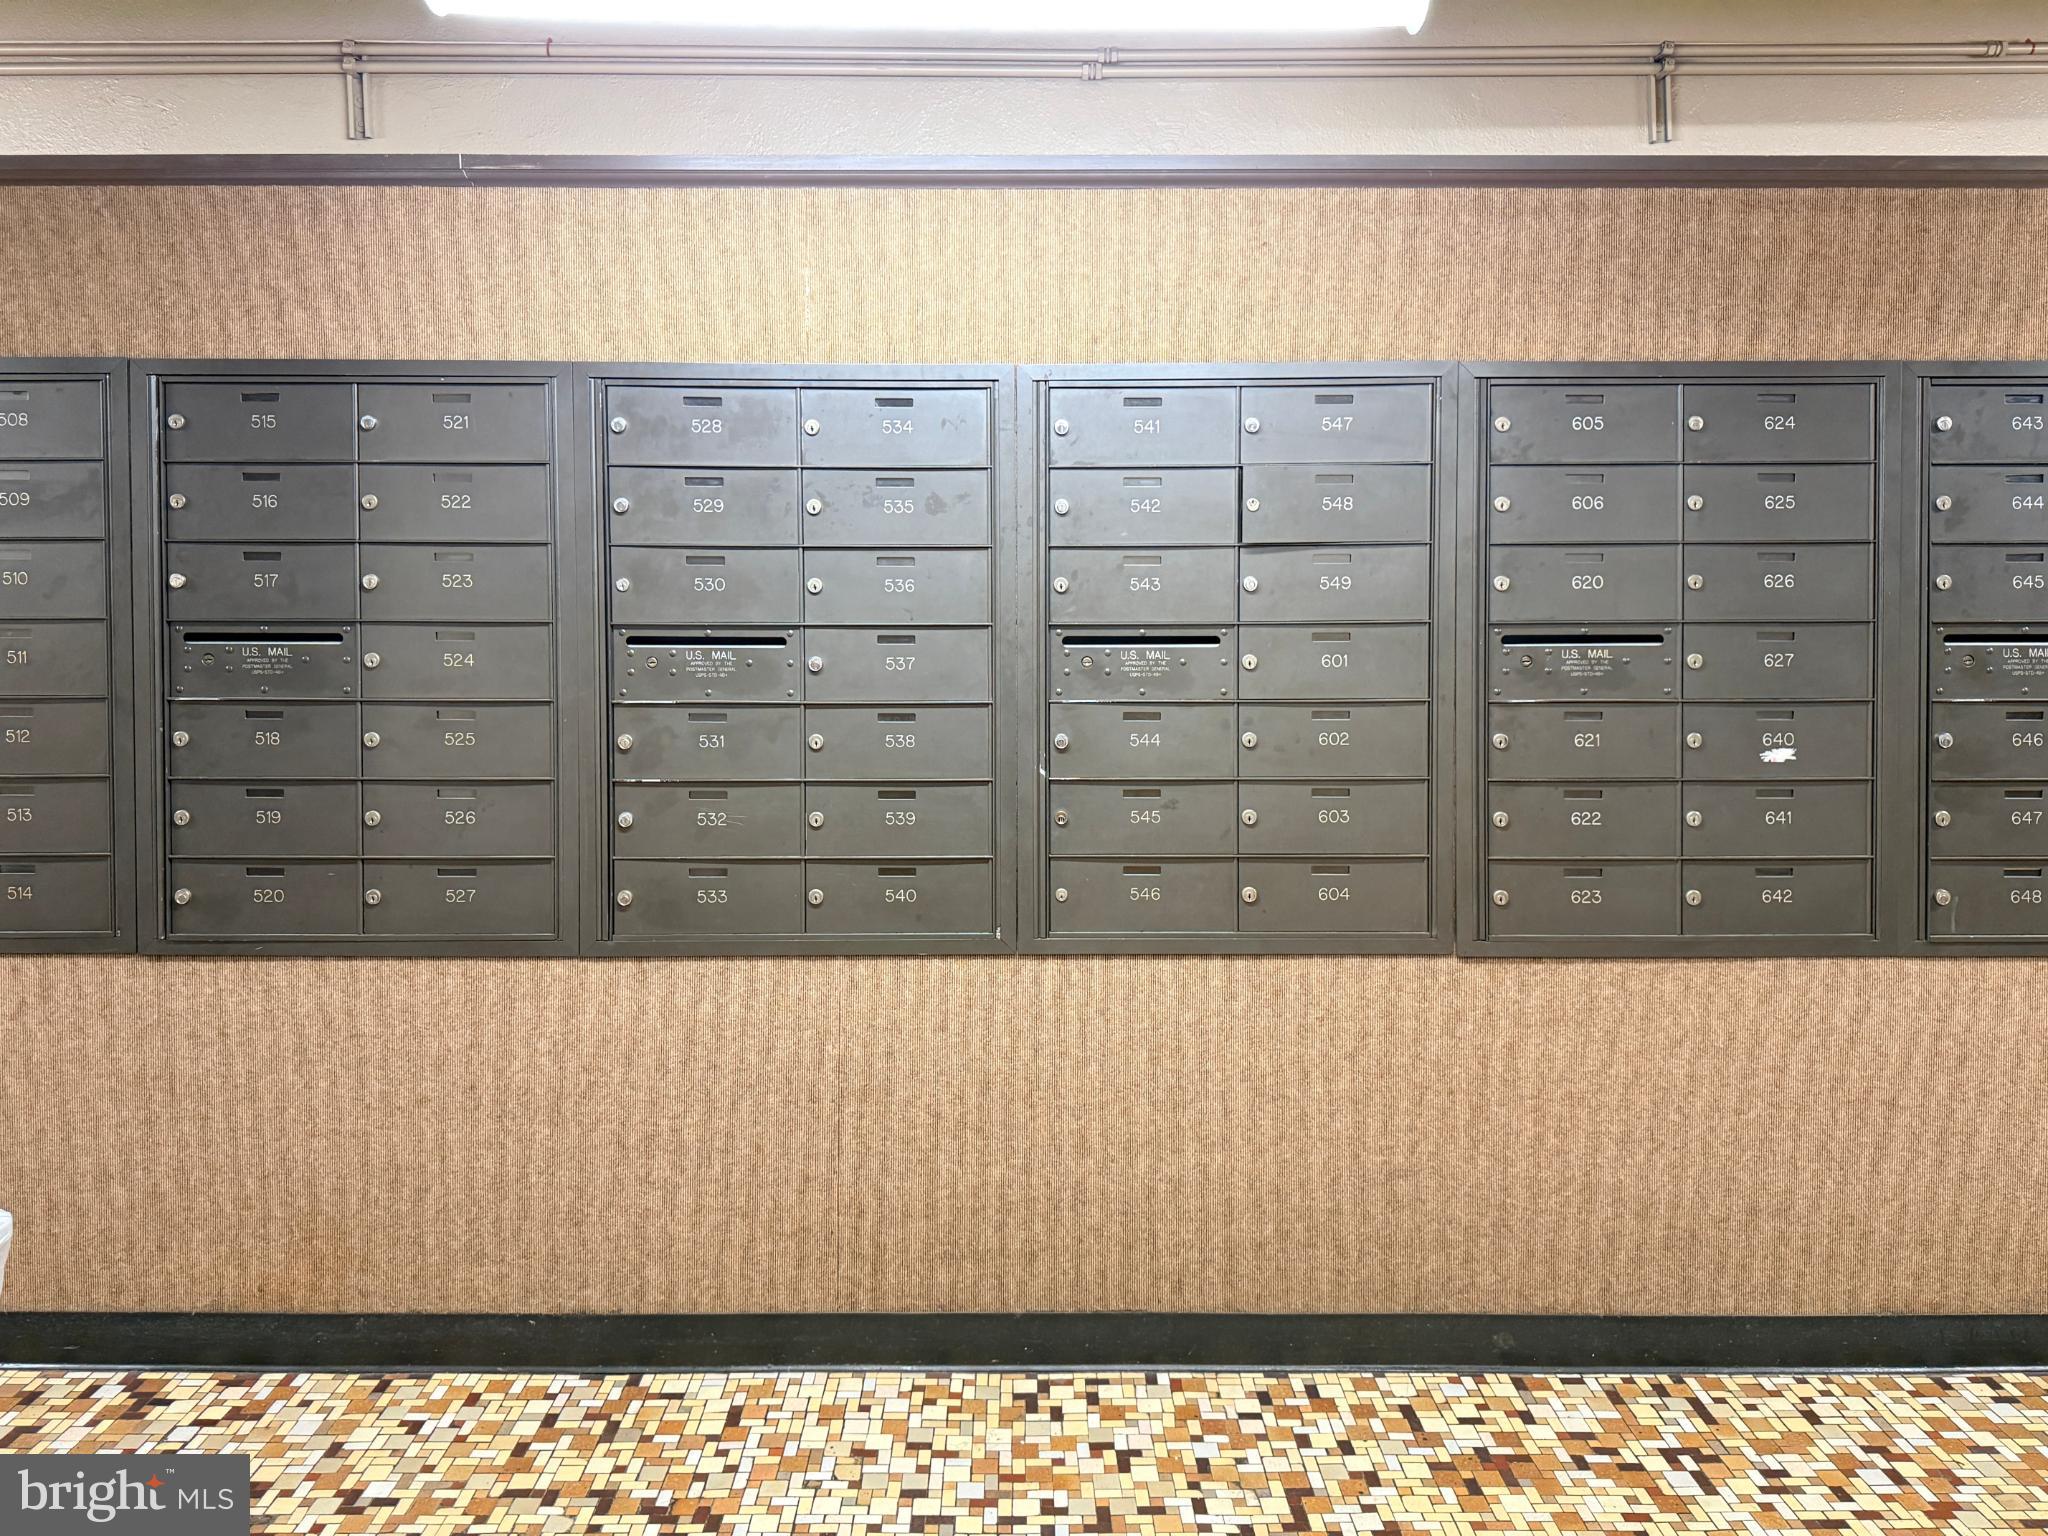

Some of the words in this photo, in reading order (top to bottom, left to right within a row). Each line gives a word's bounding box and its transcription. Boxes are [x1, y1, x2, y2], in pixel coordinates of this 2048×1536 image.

[0, 412, 29, 427] 508
[251, 414, 277, 429] 515
[443, 415, 469, 430] 521
[691, 418, 722, 434] 528
[882, 419, 914, 434] 534
[1133, 419, 1160, 434] 541
[1321, 416, 1354, 432] 547
[1572, 416, 1604, 431] 605
[1764, 415, 1796, 430] 624
[2011, 416, 2044, 431] 643
[0, 492, 30, 506] 509
[252, 494, 278, 508] 516
[441, 494, 472, 509] 522
[693, 498, 724, 513] 529
[883, 499, 914, 514] 535
[1130, 498, 1161, 513] 542
[1321, 496, 1354, 511] 548
[1571, 495, 1604, 510] 606
[1764, 495, 1796, 510] 625
[2012, 495, 2045, 510] 644
[2, 571, 28, 585] 510
[253, 573, 279, 588] 517
[442, 573, 473, 588] 523
[694, 577, 726, 592] 530
[884, 578, 915, 593] 536
[1129, 577, 1161, 592] 543
[1319, 575, 1352, 590] 549
[1571, 575, 1604, 590] 620
[1763, 574, 1795, 588] 626
[2012, 574, 2045, 589] 645
[6, 650, 27, 664] 511
[242, 647, 261, 657] U.S.
[267, 647, 293, 657] MAIL
[685, 650, 705, 660] U.S.
[711, 650, 737, 660] MAIL
[1120, 650, 1139, 660] U.S.
[1146, 650, 1171, 660] MAIL
[1561, 649, 1581, 659] U.S.
[1587, 649, 1613, 659] MAIL
[2002, 648, 2022, 658] U.S.
[443, 653, 475, 667] 524
[885, 656, 916, 671] 537
[1321, 654, 1348, 668] 601
[1764, 653, 1795, 668] 627
[5, 729, 31, 743] 512
[255, 731, 280, 746] 518
[444, 732, 476, 746] 525
[698, 734, 725, 748] 531
[885, 734, 916, 748] 538
[1129, 733, 1161, 747] 544
[1318, 731, 1350, 746] 602
[1574, 733, 1600, 748] 621
[1762, 732, 1795, 747] 640
[2012, 732, 2044, 747] 646
[7, 807, 33, 822] 513
[256, 810, 281, 824] 519
[444, 810, 476, 825] 526
[697, 812, 726, 826] 532
[885, 811, 916, 826] 539
[1130, 810, 1161, 824] 545
[1318, 809, 1350, 824] 603
[1570, 811, 1602, 826] 622
[1765, 810, 1792, 825] 641
[2011, 811, 2043, 825] 647
[7, 886, 33, 900] 514
[253, 889, 285, 903] 520
[445, 889, 476, 903] 527
[696, 889, 728, 904] 533
[885, 889, 917, 903] 540
[1129, 887, 1161, 901] 546
[1318, 887, 1350, 901] 604
[1570, 889, 1602, 904] 623
[1762, 888, 1793, 904] 642
[2010, 889, 2042, 904] 648
